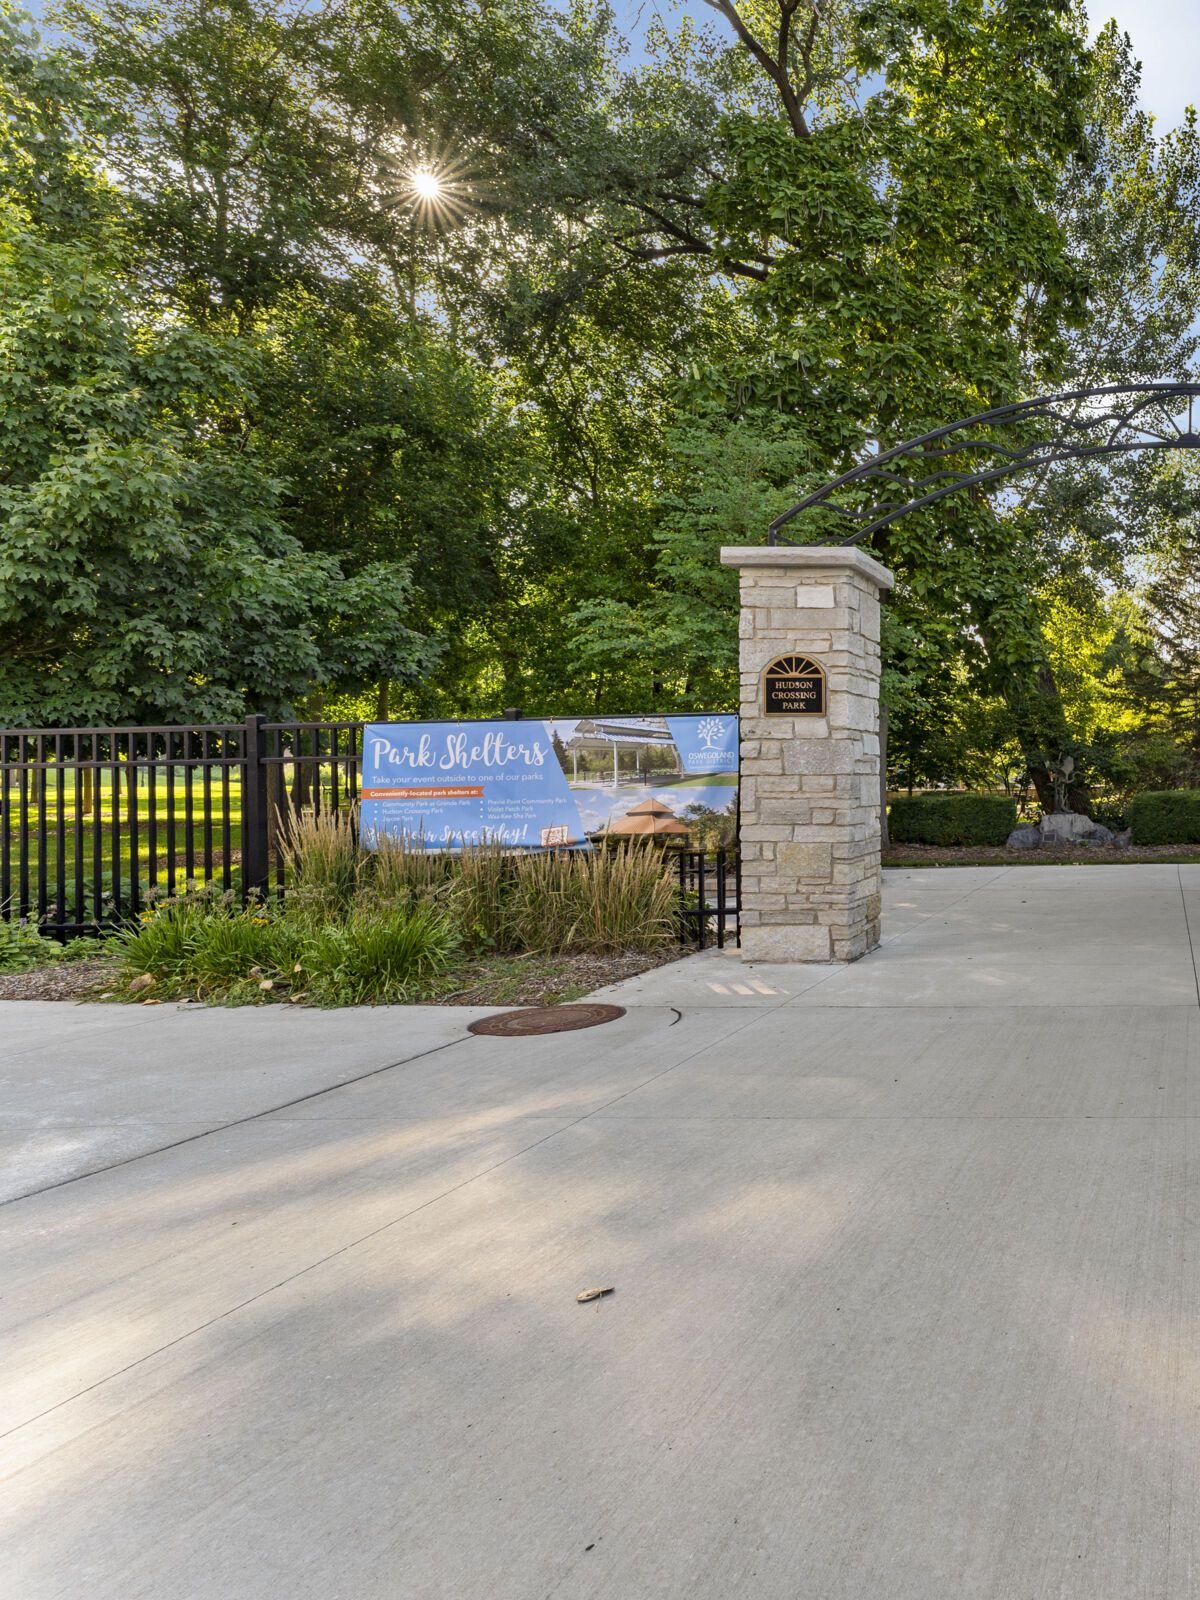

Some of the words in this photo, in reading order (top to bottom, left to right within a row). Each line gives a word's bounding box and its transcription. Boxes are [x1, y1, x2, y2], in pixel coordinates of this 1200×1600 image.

[775, 681, 813, 689] HUDSON
[771, 691, 816, 699] CROSSING
[782, 701, 806, 710] PARK
[369, 734, 436, 769] Park
[439, 732, 549, 770] Shelters
[688, 751, 735, 760] OSWEGOLAND
[372, 776, 390, 784] Take
[392, 777, 411, 785] your
[437, 774, 465, 782] outside
[495, 773, 504, 781] of
[521, 772, 544, 782] parks
[439, 825, 479, 843] Space
[480, 823, 528, 845] Today!
